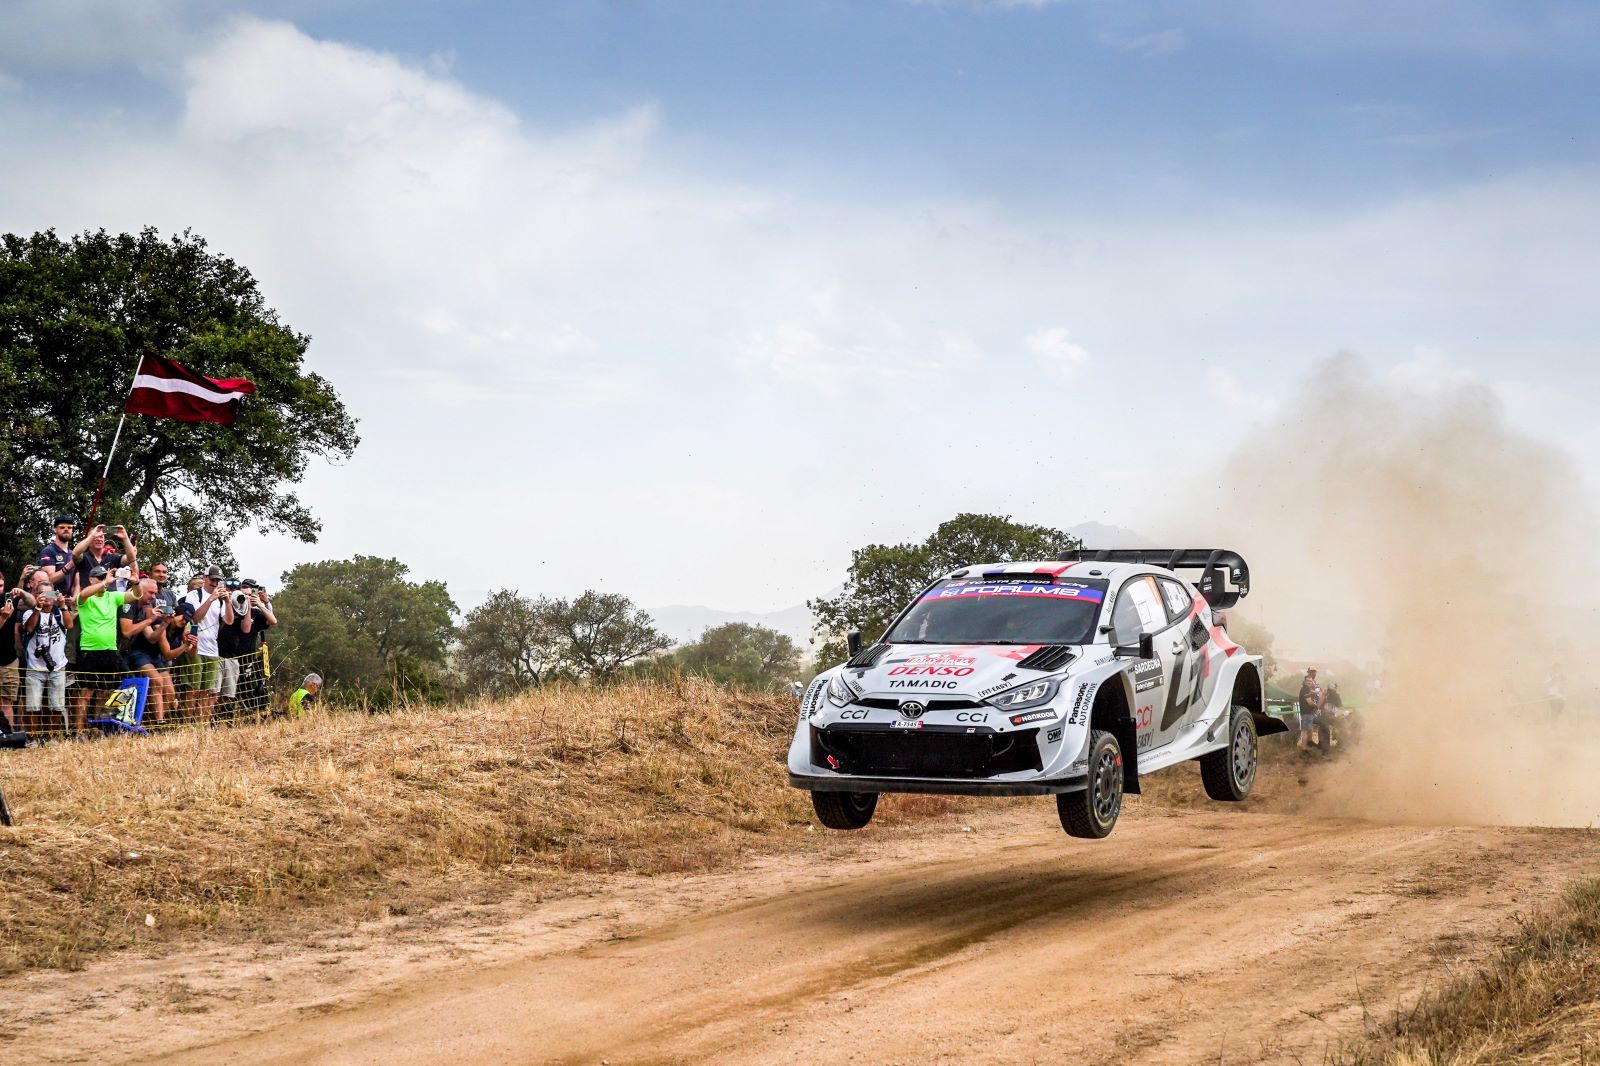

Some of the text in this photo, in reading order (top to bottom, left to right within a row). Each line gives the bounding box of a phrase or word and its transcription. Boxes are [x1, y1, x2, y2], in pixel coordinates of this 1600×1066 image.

[962, 585, 1080, 596] FORUM8
[887, 666, 975, 677] DENSO
[1134, 658, 1162, 674] SARDEGNA
[889, 680, 958, 690] TAMADIC
[1068, 682, 1089, 725] Panasonic
[1078, 682, 1098, 727] AUTOMOTIVE
[1047, 729, 1062, 742] OMP
